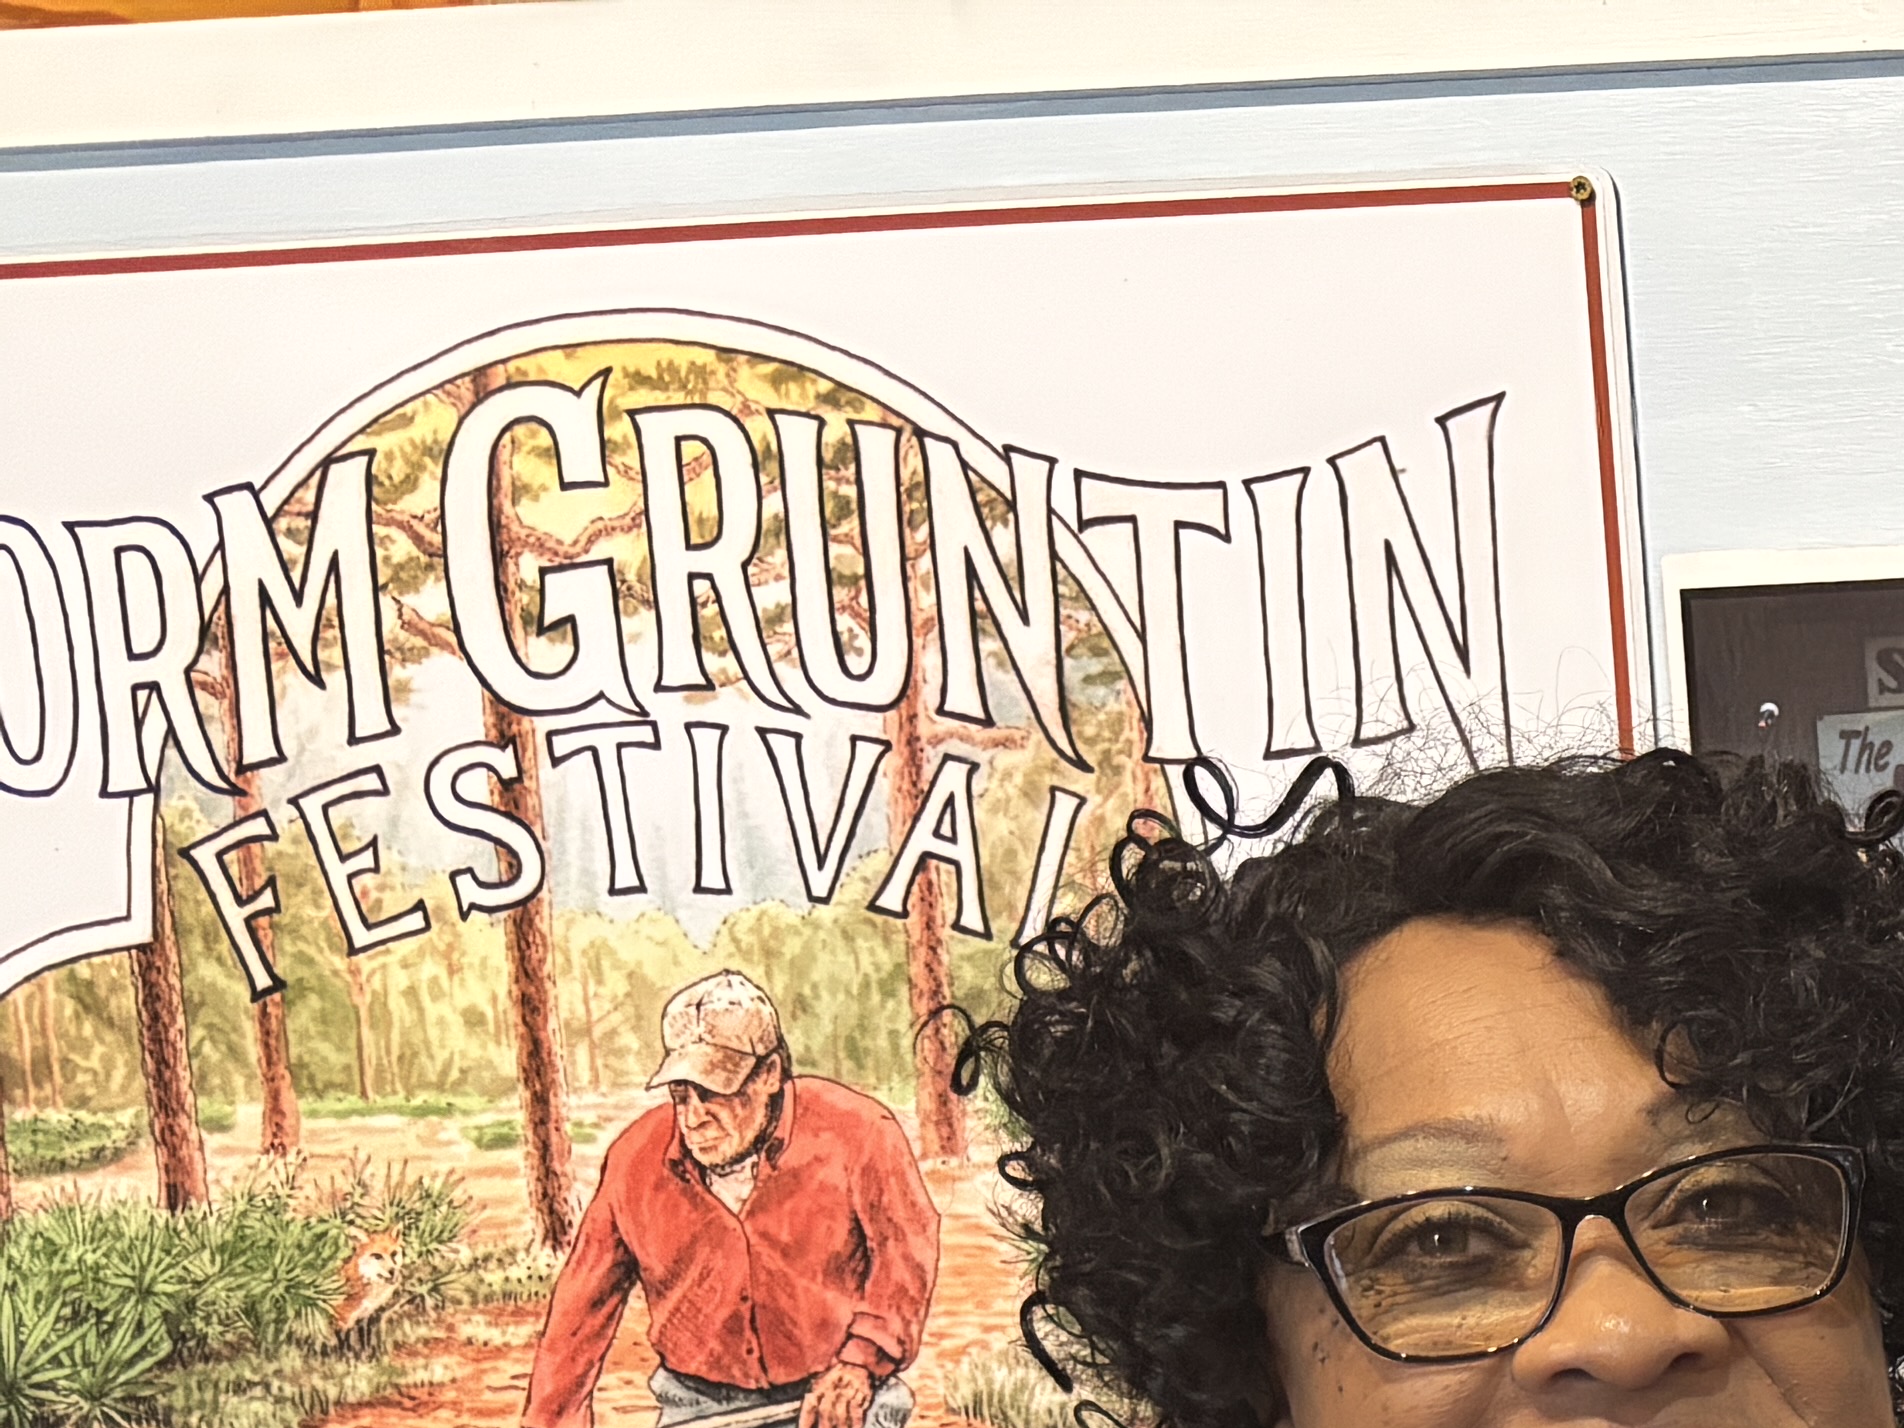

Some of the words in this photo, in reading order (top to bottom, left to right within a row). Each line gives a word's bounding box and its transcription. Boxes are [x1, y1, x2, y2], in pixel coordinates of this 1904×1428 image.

[0, 452, 400, 800] ORM
[443, 368, 1511, 772] GRUNTIN
[1838, 728, 1893, 775] The
